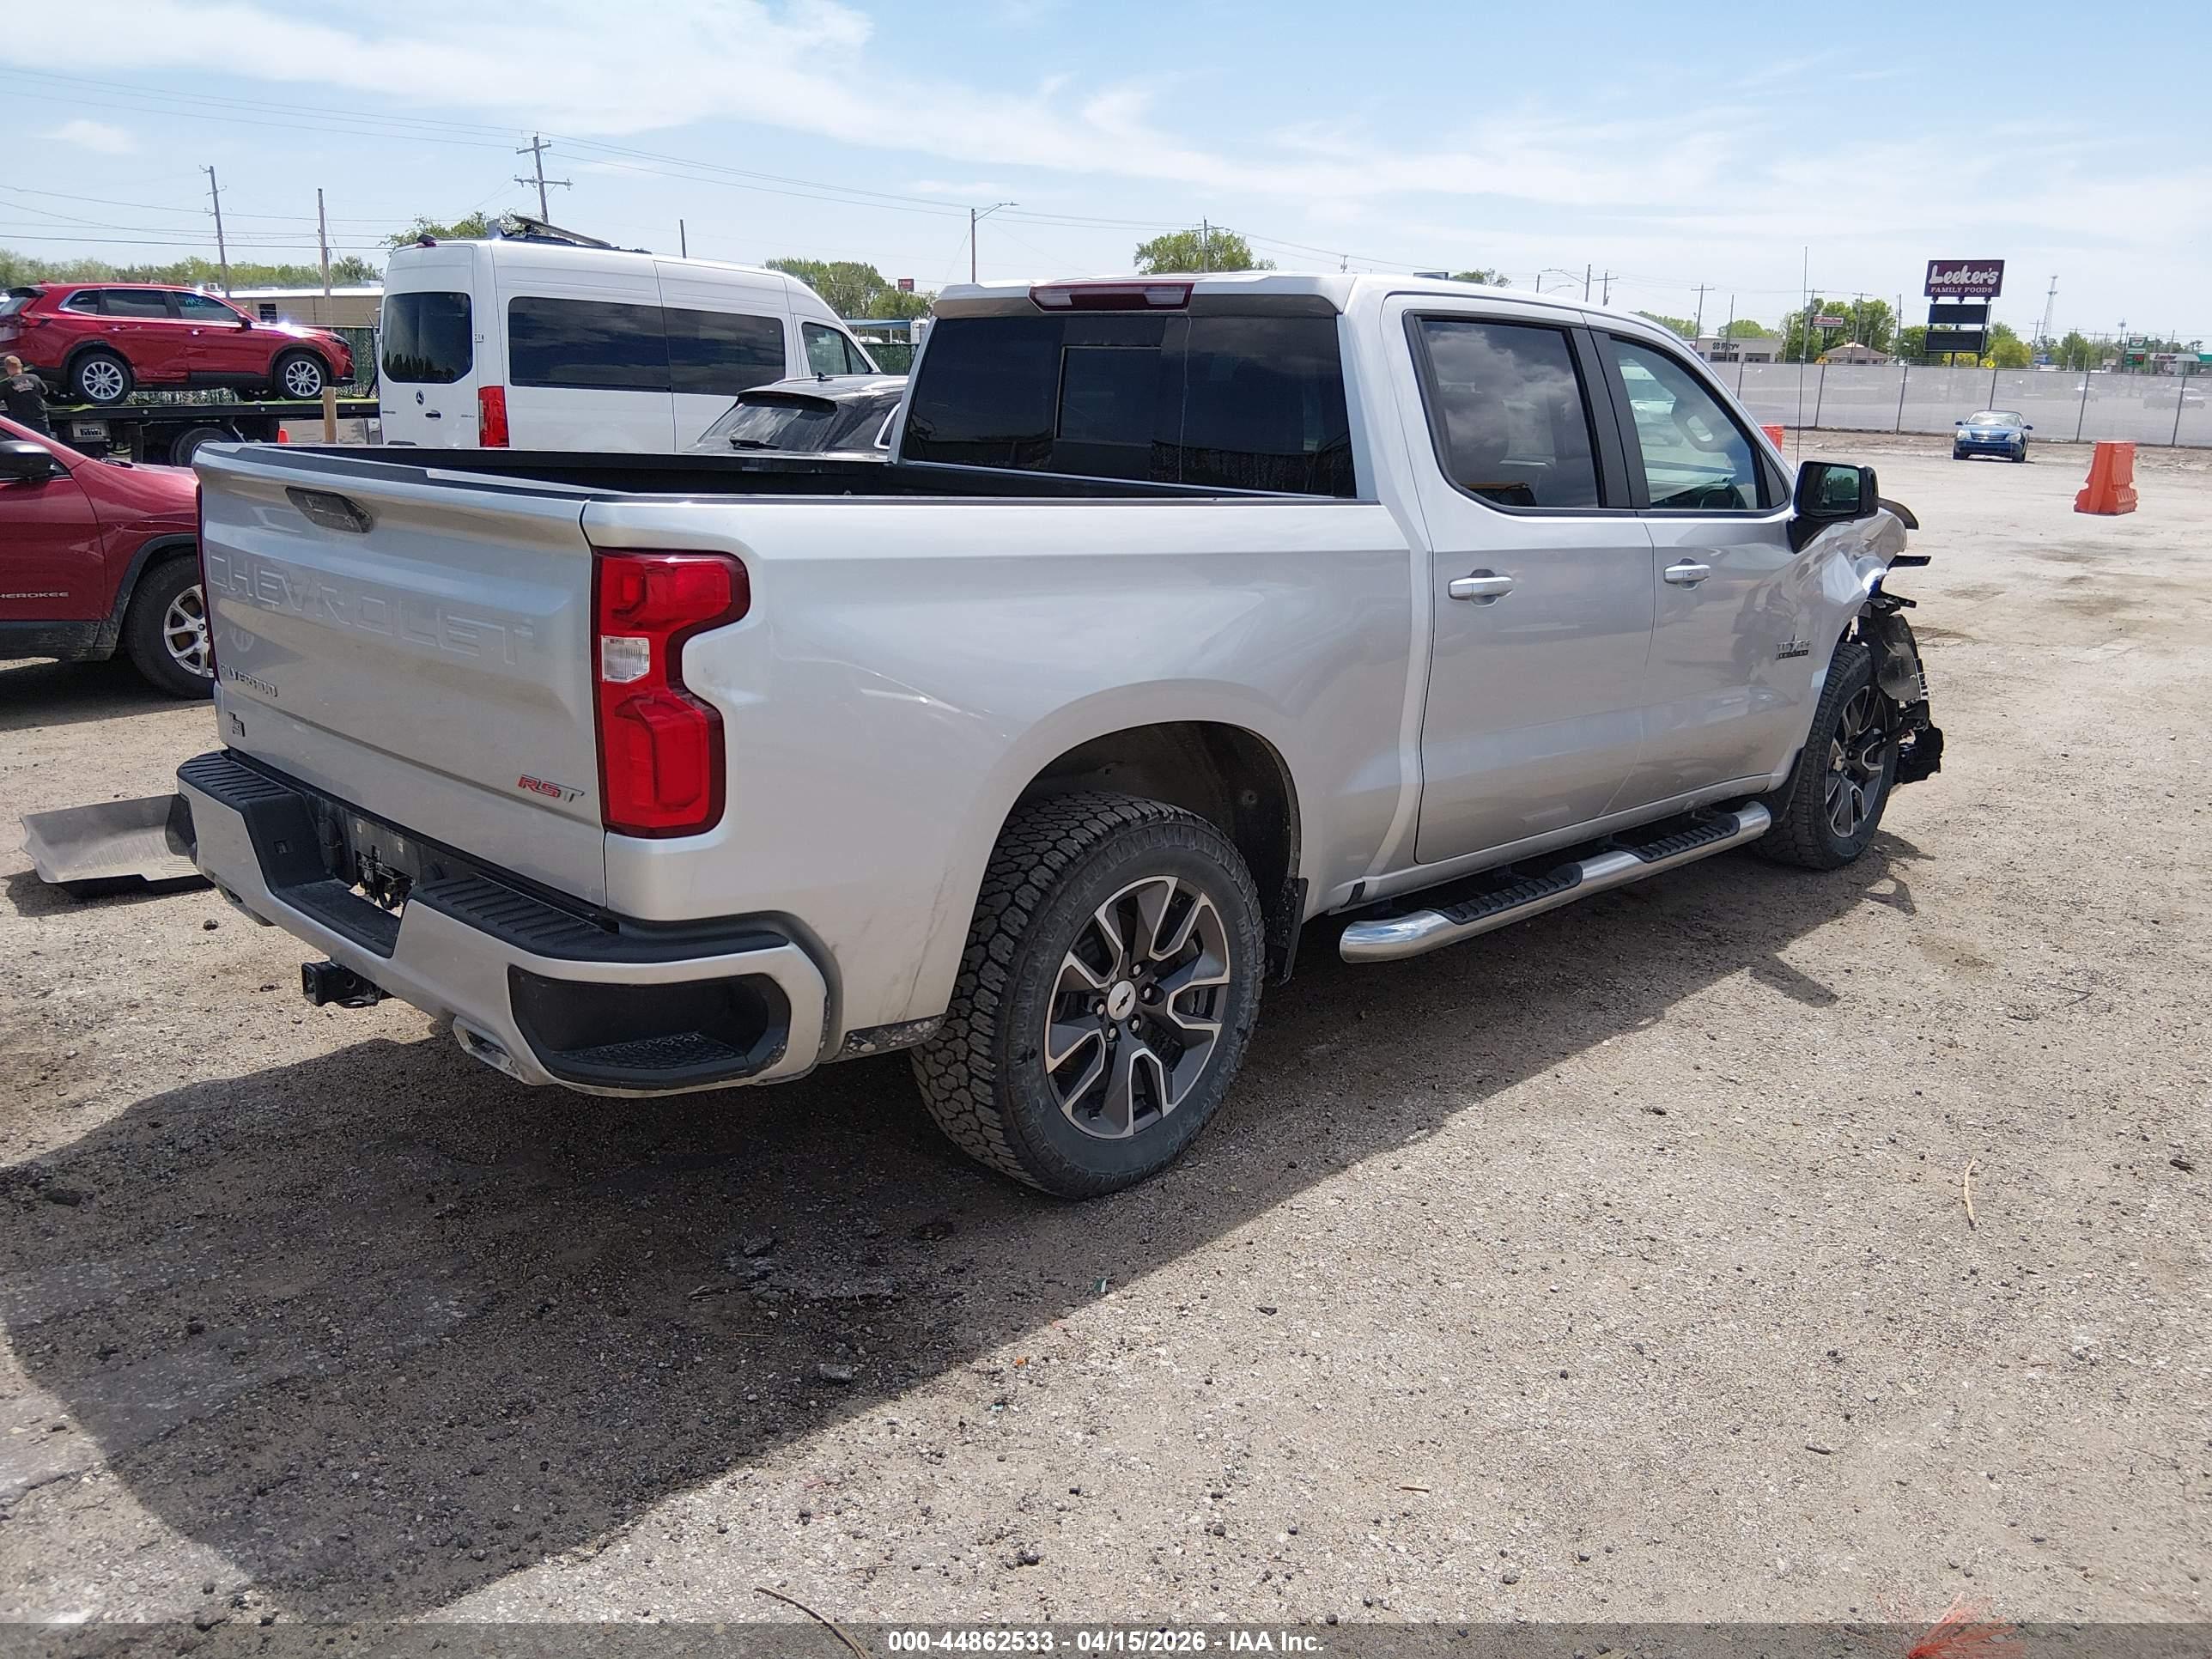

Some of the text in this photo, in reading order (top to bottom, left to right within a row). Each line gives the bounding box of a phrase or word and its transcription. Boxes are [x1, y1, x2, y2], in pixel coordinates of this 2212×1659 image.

[1928, 264, 2000, 284] Leeker's
[206, 548, 534, 666] CHEVROLET
[518, 774, 586, 803] RST
